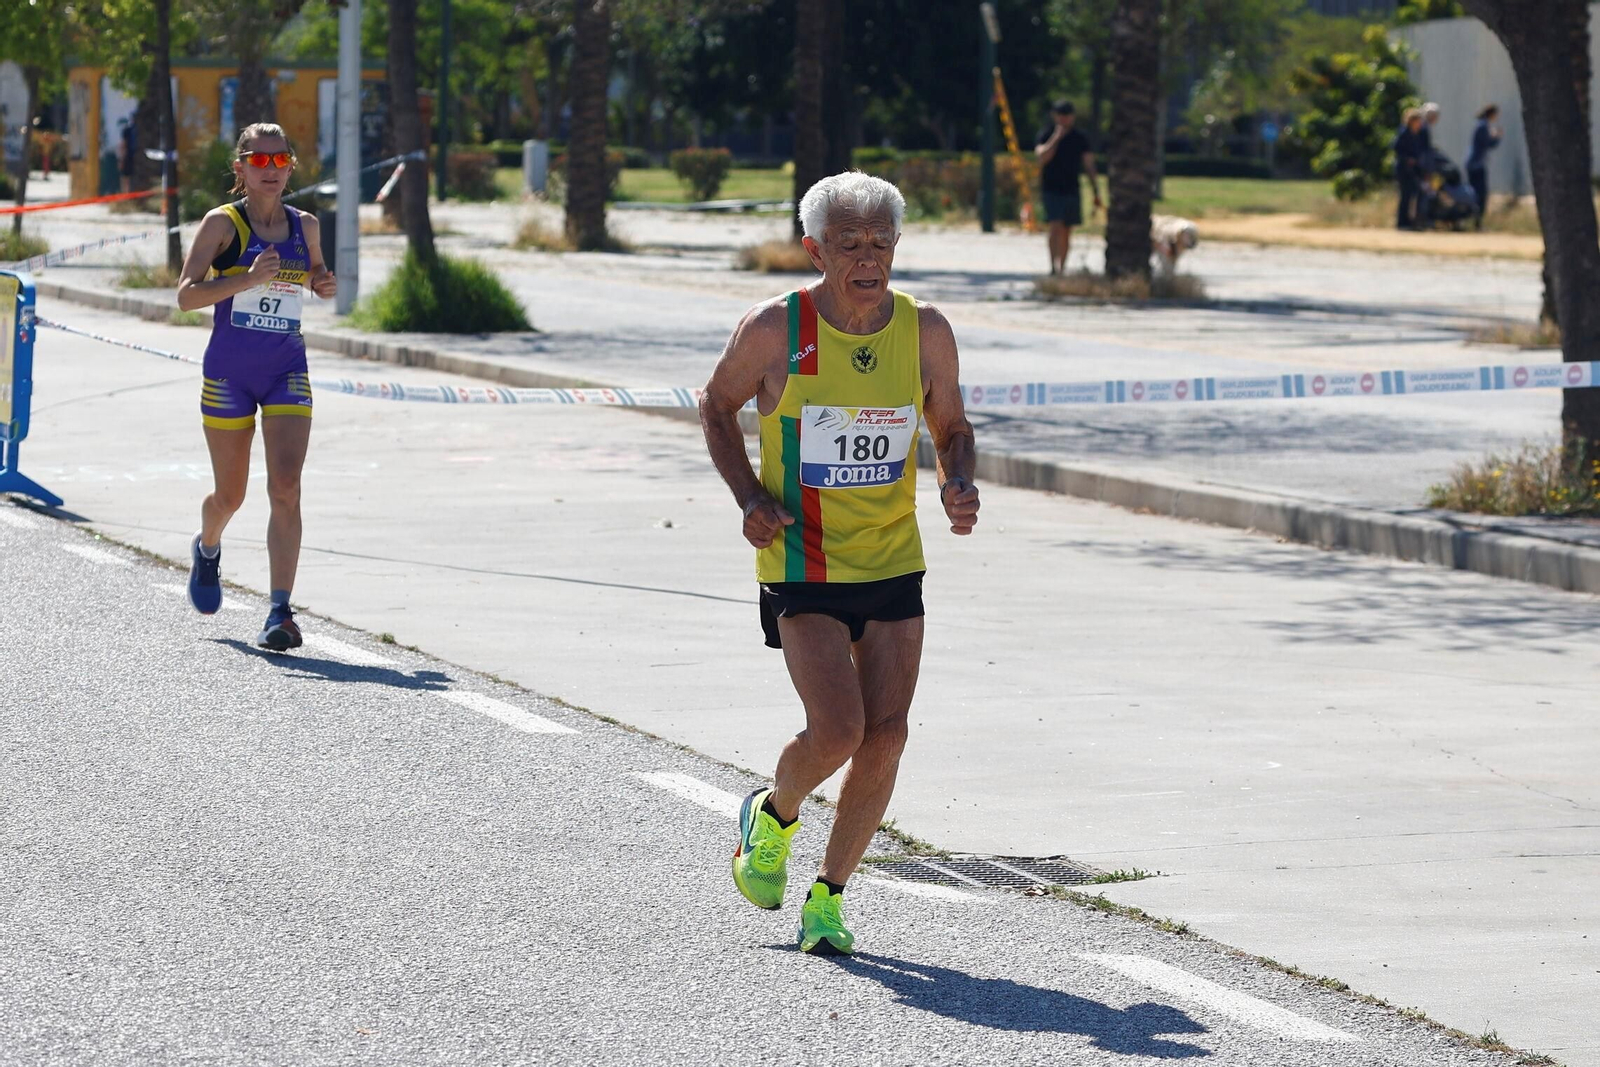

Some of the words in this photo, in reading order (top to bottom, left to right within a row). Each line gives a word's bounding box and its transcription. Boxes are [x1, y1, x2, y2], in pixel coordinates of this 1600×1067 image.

[273, 271, 304, 281] ASSOT
[259, 296, 282, 314] 67
[859, 409, 896, 418] RFEA
[855, 417, 908, 425] ATLETISMO
[834, 434, 890, 461] 180
